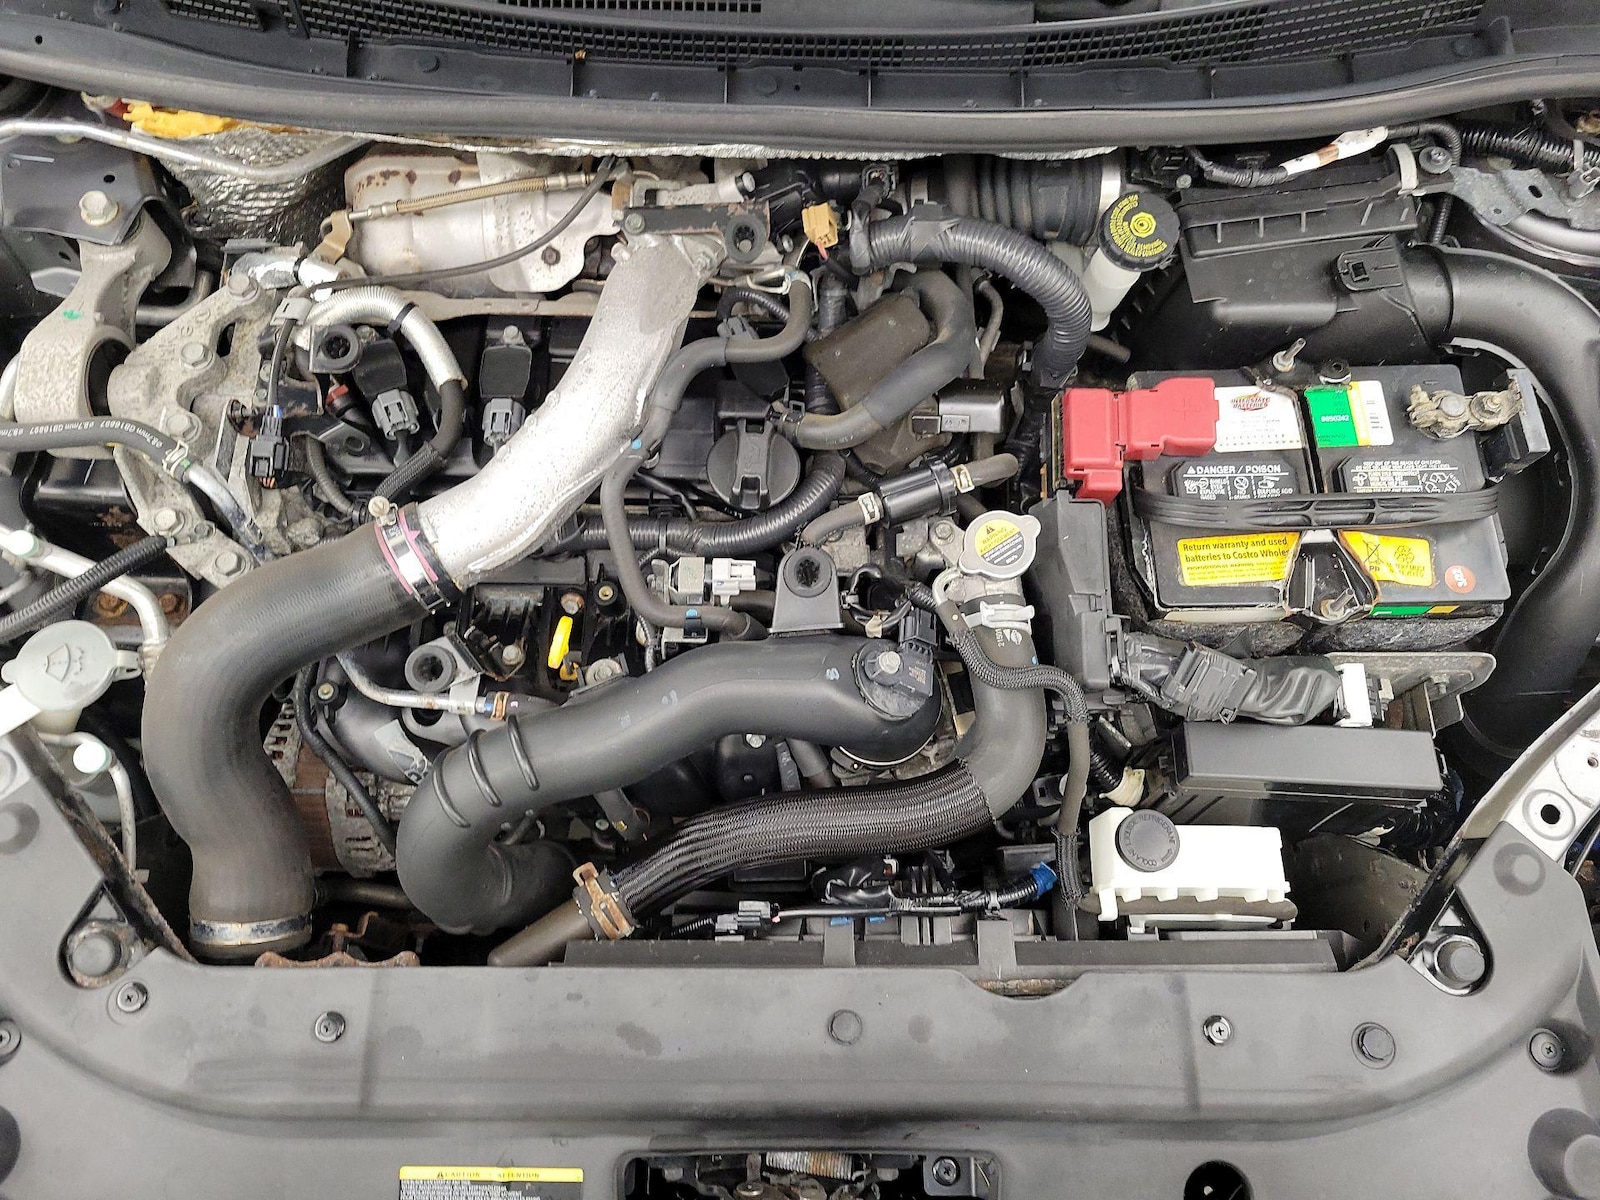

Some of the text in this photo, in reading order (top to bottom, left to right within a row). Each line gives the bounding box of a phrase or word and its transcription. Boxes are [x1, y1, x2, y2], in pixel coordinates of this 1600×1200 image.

[1196, 465, 1235, 474] DANGER
[1245, 464, 1281, 473] POISON
[1183, 537, 1288, 552] Return warranty and used
[1185, 553, 1222, 562] batteries
[1232, 551, 1258, 559] Costco
